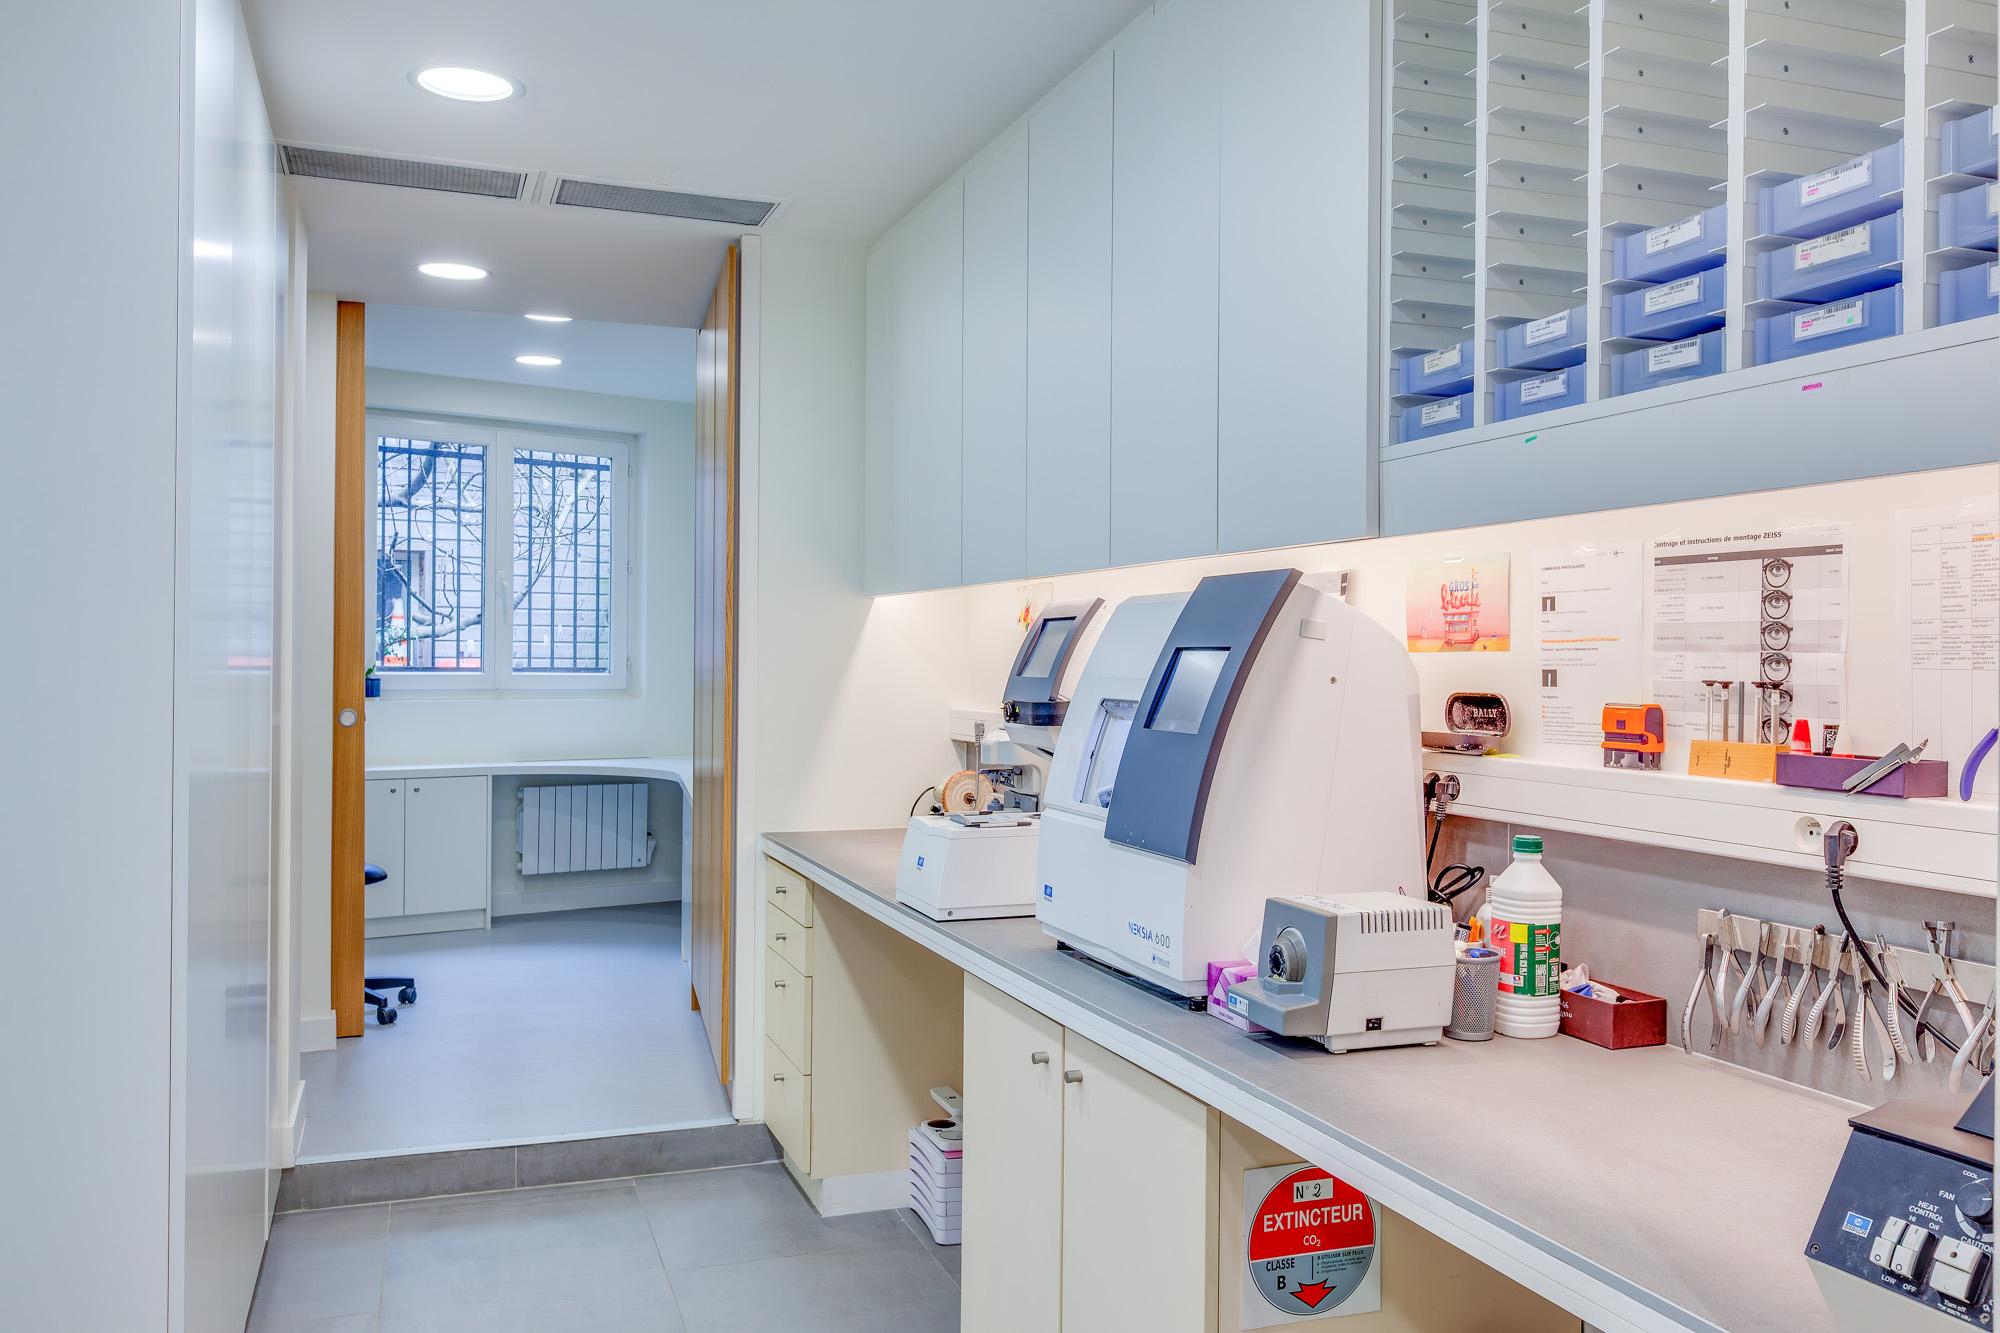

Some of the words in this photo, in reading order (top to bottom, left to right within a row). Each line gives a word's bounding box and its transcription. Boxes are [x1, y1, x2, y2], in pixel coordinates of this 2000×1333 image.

[1687, 537, 1722, 545] instructions
[1733, 533, 1762, 542] montage
[1763, 531, 1782, 539] ZEISS
[1449, 581, 1469, 592] GROS
[1473, 708, 1497, 718] BALLY
[1128, 921, 1153, 942] NEKSIA
[1155, 933, 1170, 949] 600
[1962, 1169, 1979, 1180] COOL
[1296, 1185, 1310, 1200] N°
[1312, 1183, 1321, 1198] 2
[1938, 1189, 1956, 1201] FAN
[1917, 1200, 1939, 1213] HEAT
[1263, 1203, 1363, 1233] EXTINCTEUR
[1908, 1205, 1944, 1223] CONTROL
[1928, 1222, 1940, 1231] ON
[1341, 1250, 1352, 1258] SUR
[1352, 1249, 1364, 1257] FEUX
[1266, 1258, 1295, 1272] CLASSE
[1276, 1275, 1287, 1290] B
[1880, 1274, 1897, 1285] LOW
[1902, 1283, 1918, 1294] OFF
